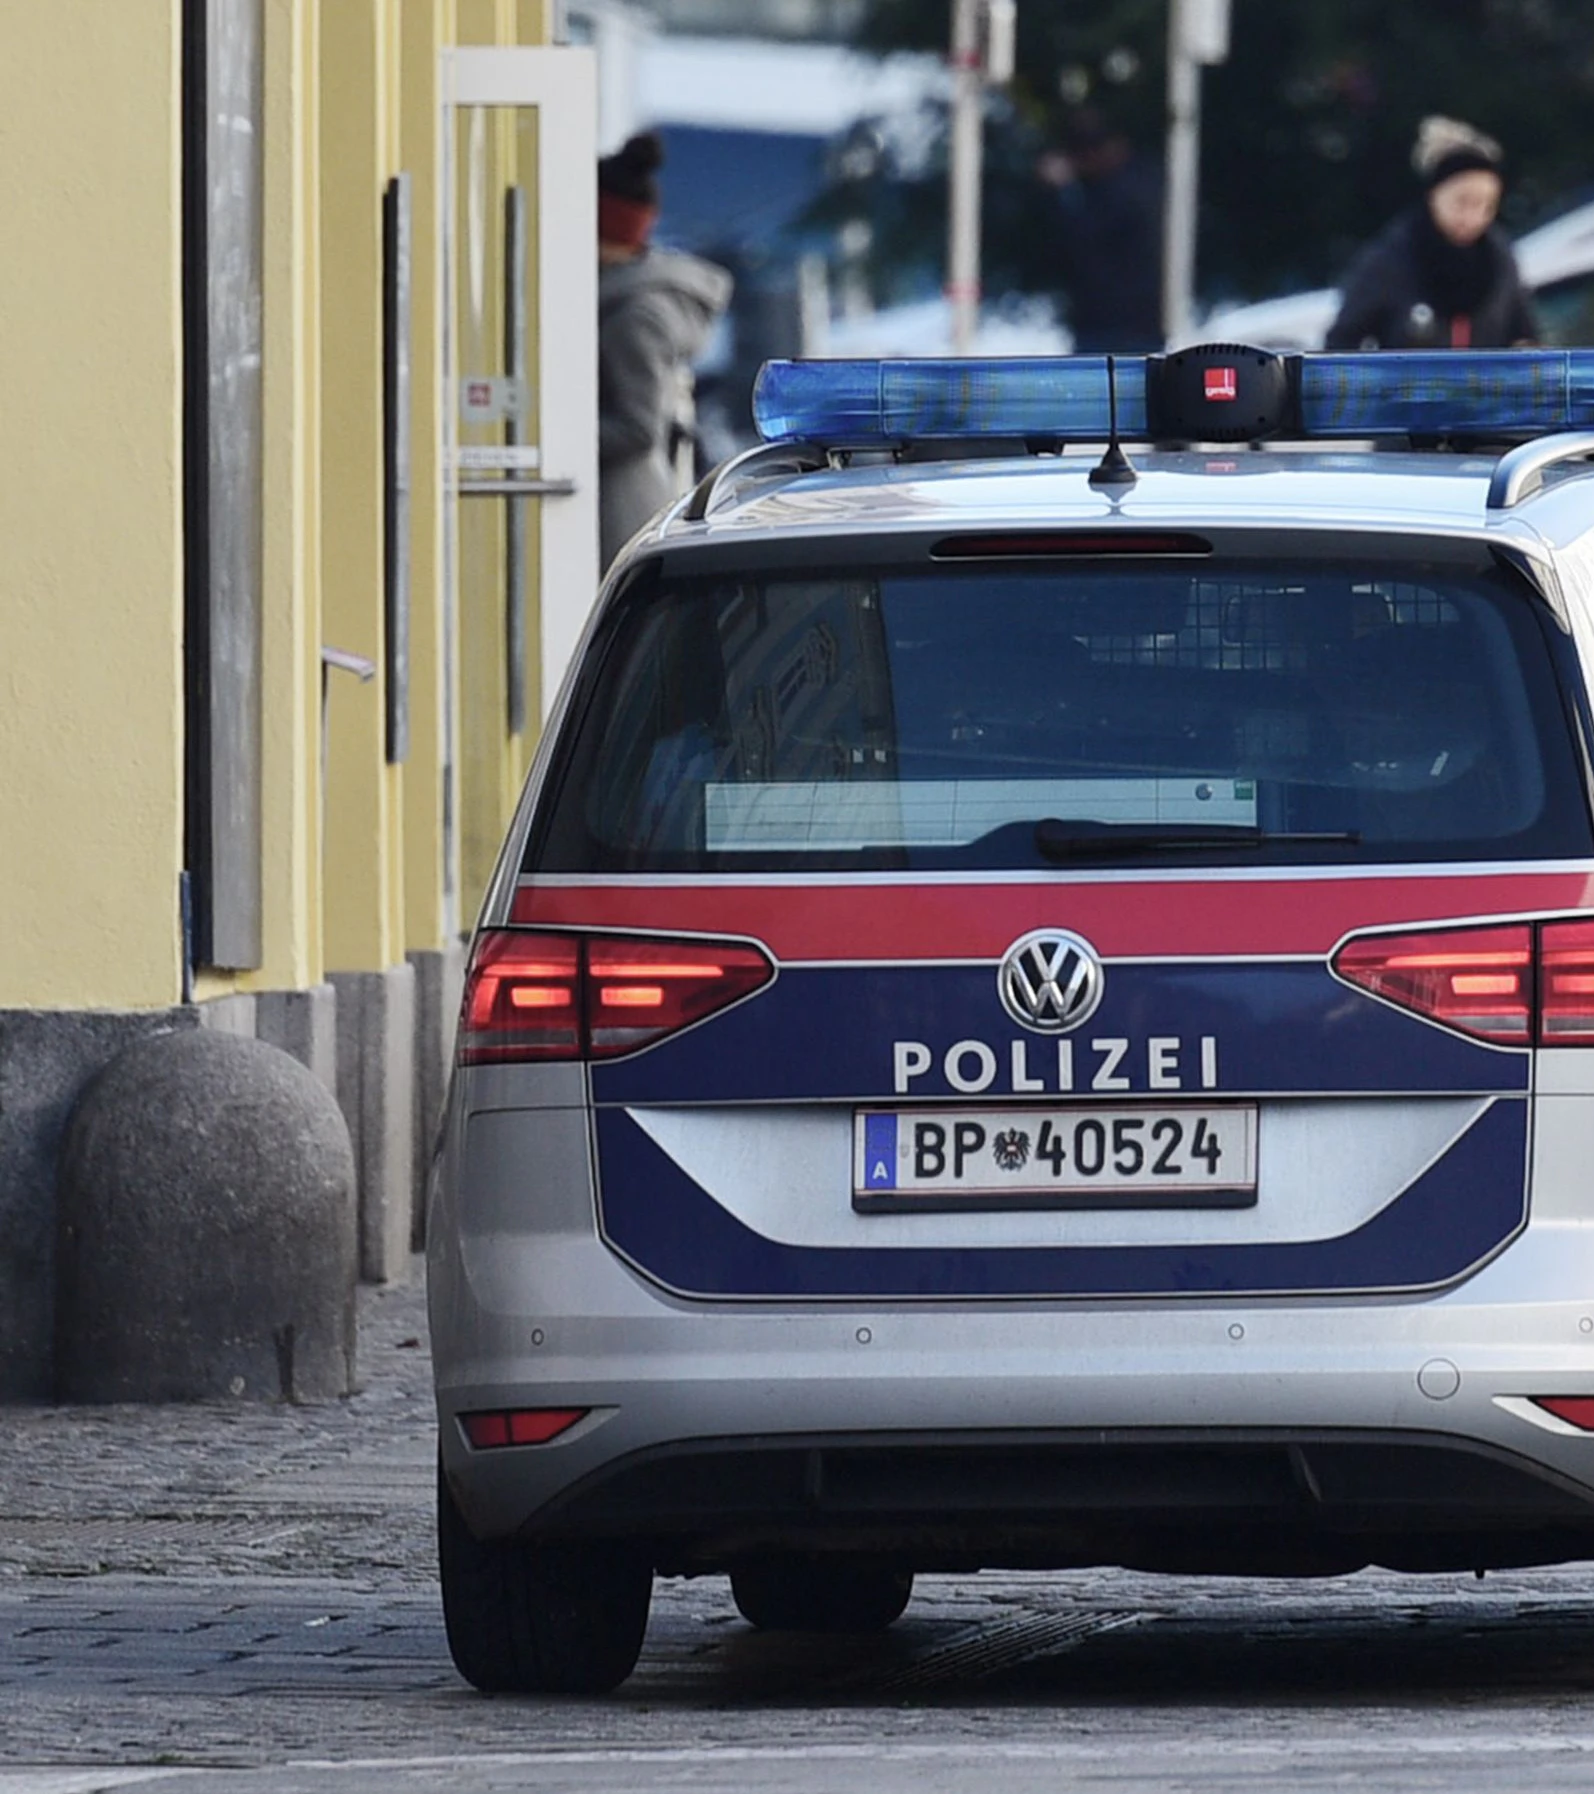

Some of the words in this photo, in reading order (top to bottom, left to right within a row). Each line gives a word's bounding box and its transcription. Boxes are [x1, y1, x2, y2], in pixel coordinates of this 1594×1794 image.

[893, 1036, 1218, 1094] POLIZEI
[872, 1160, 889, 1180] A
[914, 1121, 986, 1179] BP
[1035, 1117, 1222, 1177] 40524
